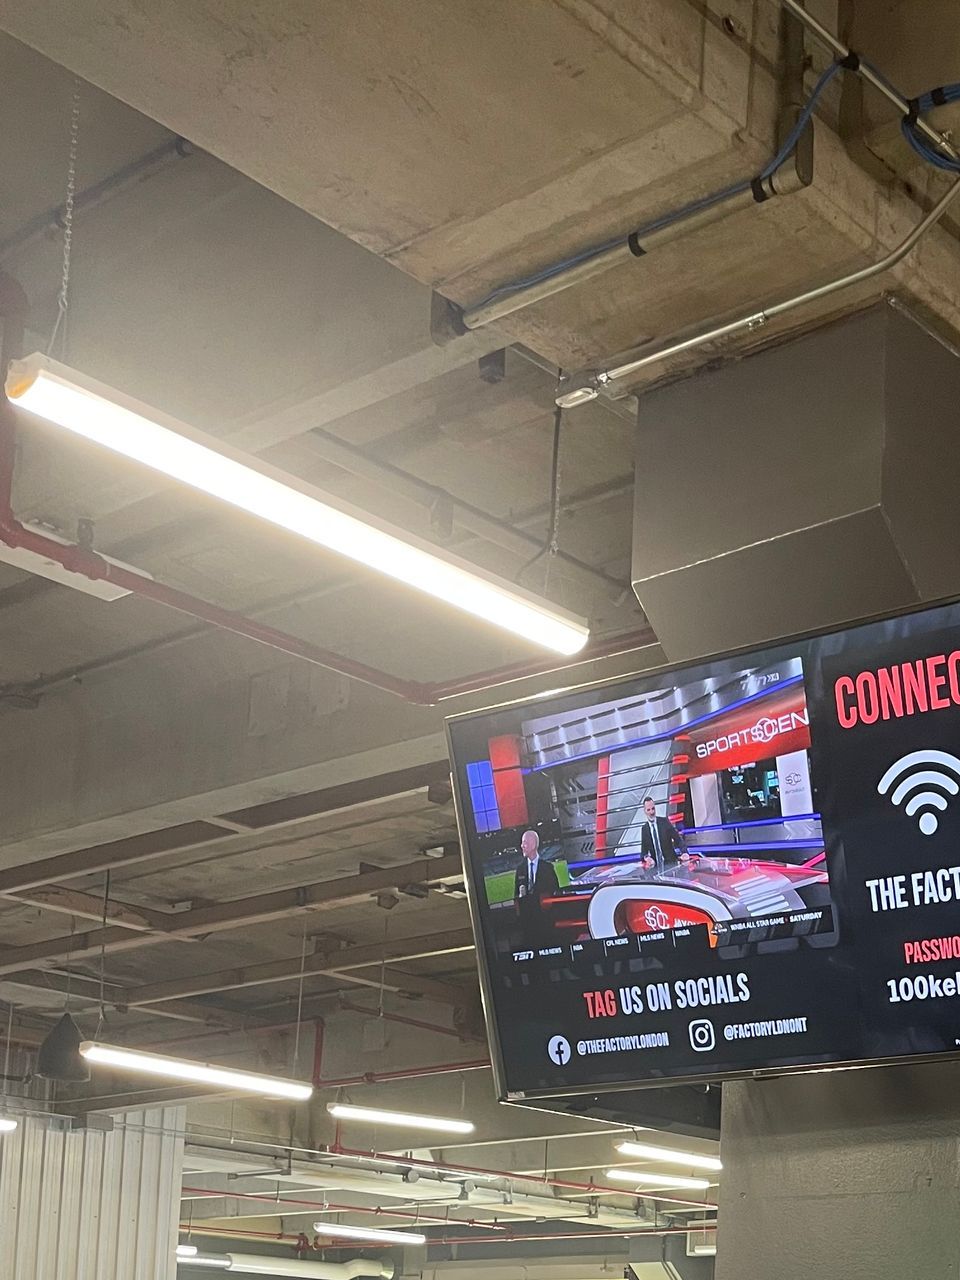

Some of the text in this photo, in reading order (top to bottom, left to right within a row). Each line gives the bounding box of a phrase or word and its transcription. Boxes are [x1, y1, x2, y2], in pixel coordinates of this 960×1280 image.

[865, 875, 909, 912] THE
[789, 912, 823, 924] SATURDAY
[512, 951, 534, 961] TSN
[583, 972, 750, 1019] TAG US ON SOCIALS
[576, 1016, 808, 1056] @THEFACTORYLONDON @FACTORYLDNONT
